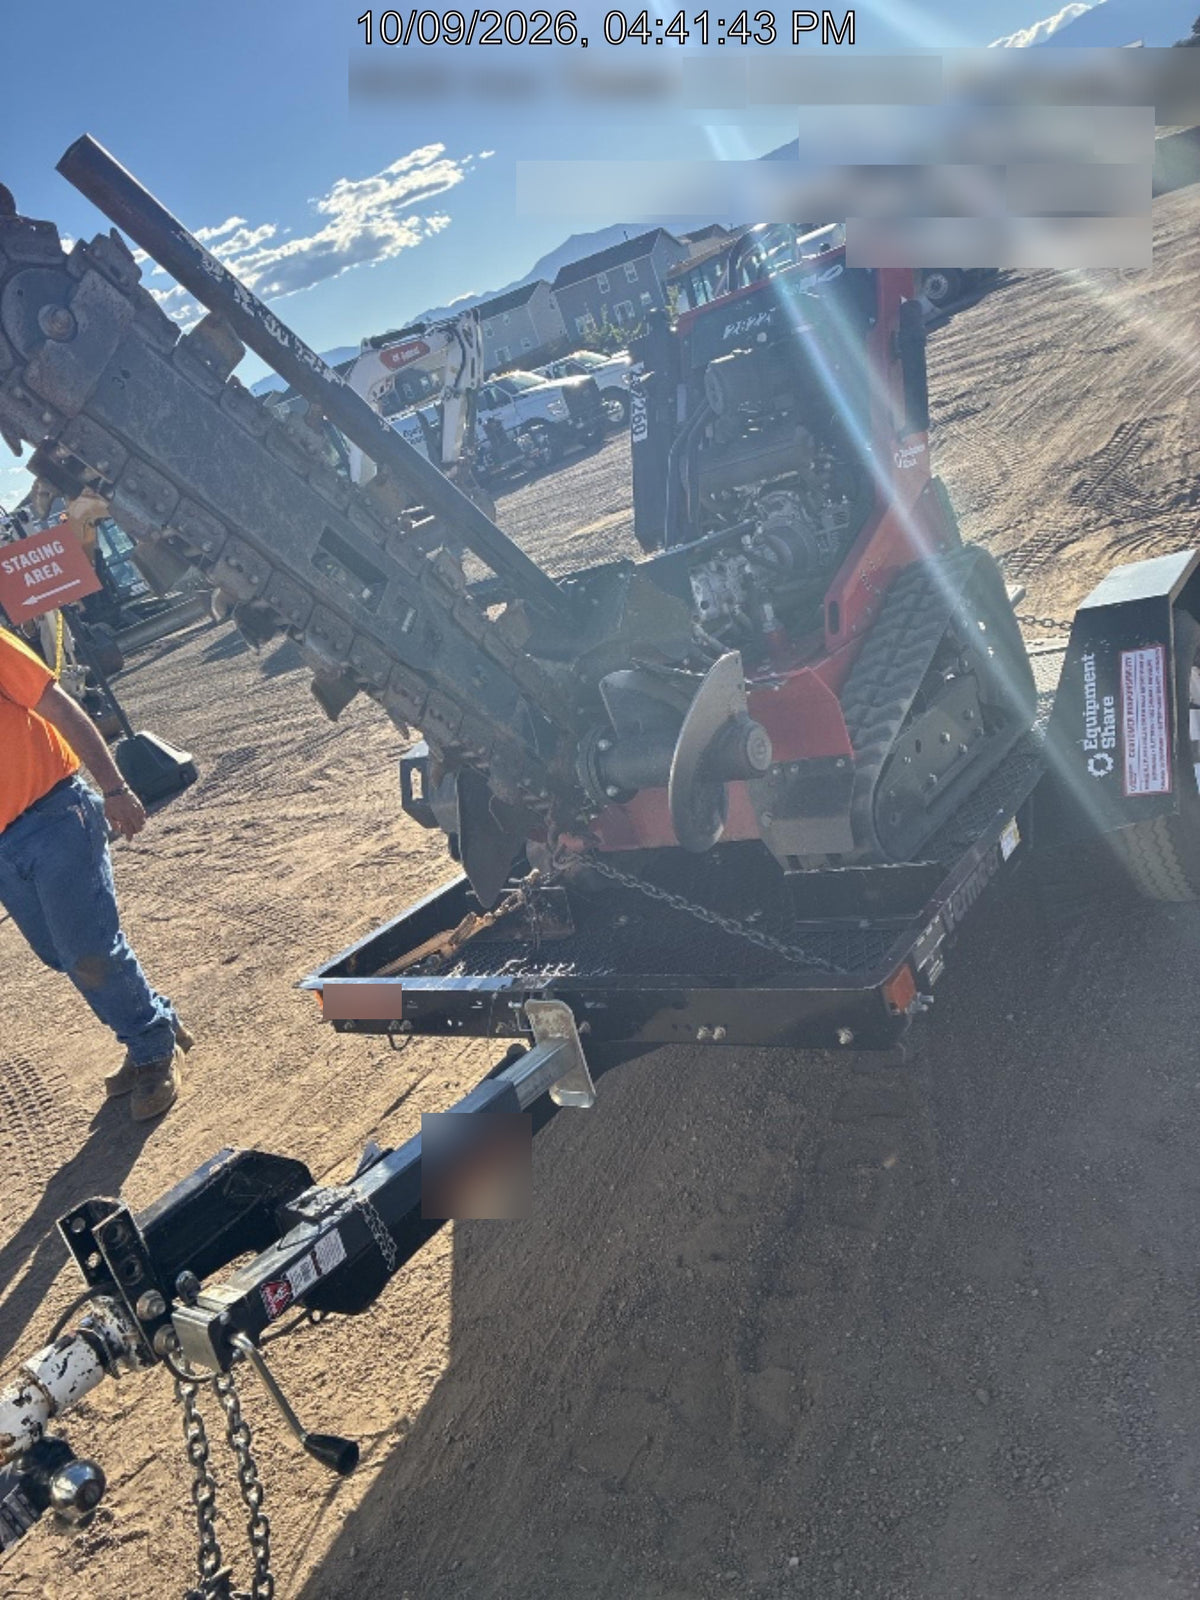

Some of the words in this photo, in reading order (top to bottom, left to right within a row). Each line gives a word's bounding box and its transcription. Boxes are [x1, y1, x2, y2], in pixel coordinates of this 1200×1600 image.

[1, 541, 65, 574] STAGING
[23, 561, 64, 587] AREA
[1082, 652, 1101, 751] Equipment
[1101, 695, 1116, 749] Share
